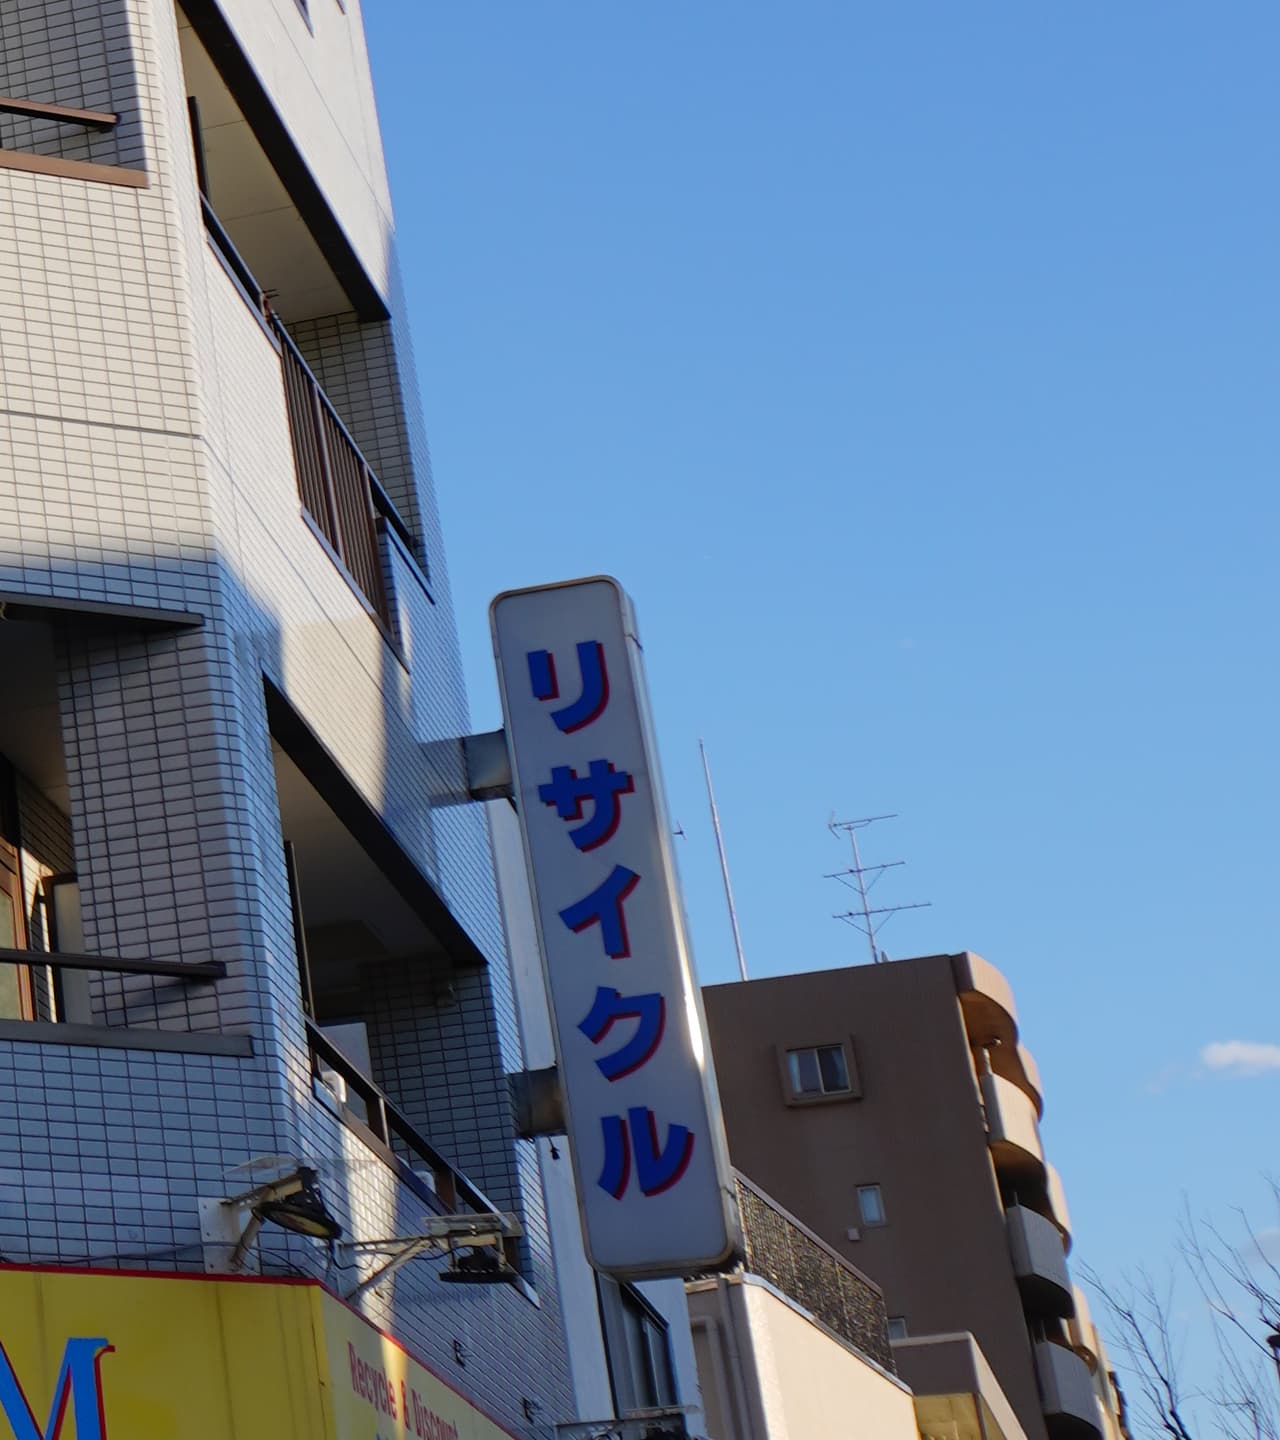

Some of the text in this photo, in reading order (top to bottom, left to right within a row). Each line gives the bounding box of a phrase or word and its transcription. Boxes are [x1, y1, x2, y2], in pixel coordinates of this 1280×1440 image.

[526, 639, 696, 1202] リサイクル
[347, 1341, 398, 1418] Recycle
